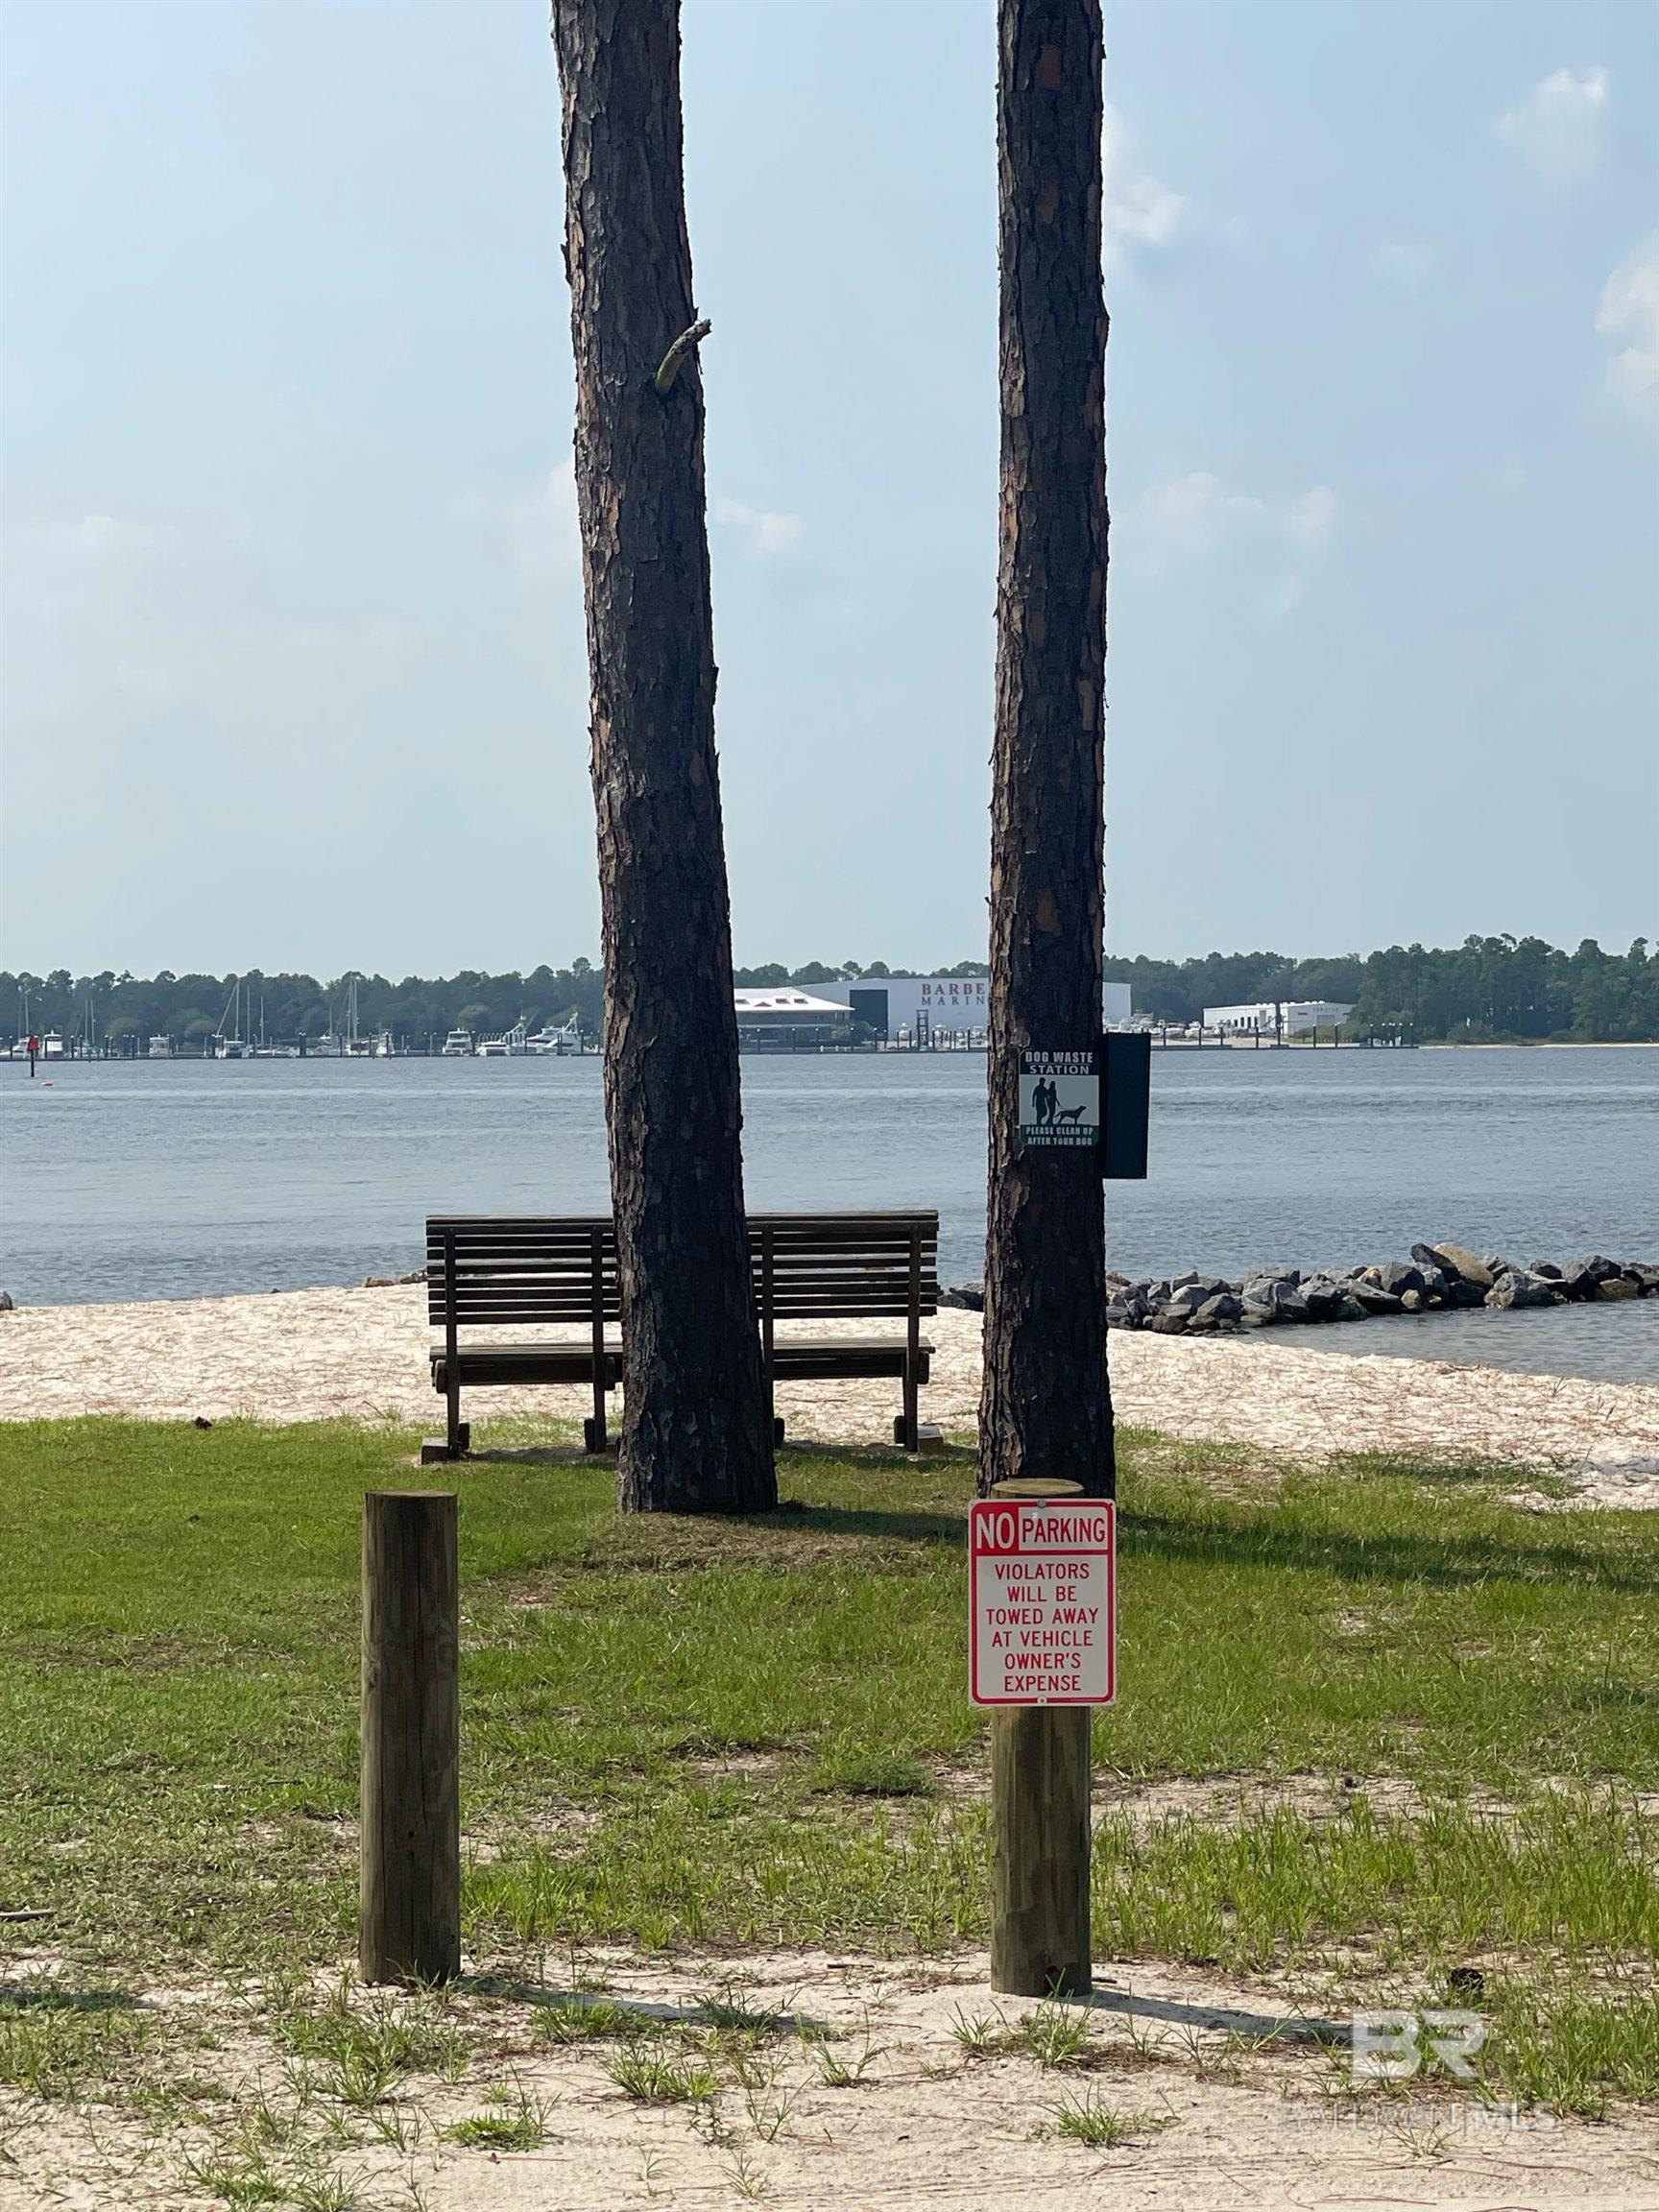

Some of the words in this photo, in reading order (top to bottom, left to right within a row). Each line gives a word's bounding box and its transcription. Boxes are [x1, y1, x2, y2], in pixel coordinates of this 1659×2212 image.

[1025, 1051, 1048, 1062] DOG
[1053, 1051, 1093, 1063] WASTE
[1029, 1065, 1090, 1074] STATION
[1025, 1126, 1053, 1135] PLEASE
[1056, 1126, 1080, 1135] CLEAN
[1083, 1126, 1094, 1135] UP
[1027, 1137, 1050, 1145] AFTER
[1053, 1137, 1073, 1145] YOUR
[1076, 1137, 1093, 1145] DOG
[976, 1512, 1015, 1549] NO
[1022, 1518, 1105, 1543] PARKING
[995, 1563, 1089, 1579] VIOLATORS
[1007, 1586, 1046, 1602] WILL
[1056, 1585, 1077, 1601] BE
[986, 1608, 1043, 1624] TOWED
[1052, 1608, 1098, 1624] AWAY
[992, 1631, 1012, 1647] AT
[1021, 1630, 1093, 1647] VEHICLE
[1005, 1652, 1081, 1670] OWNER'S
[1005, 1675, 1081, 1692] EXPENSE
